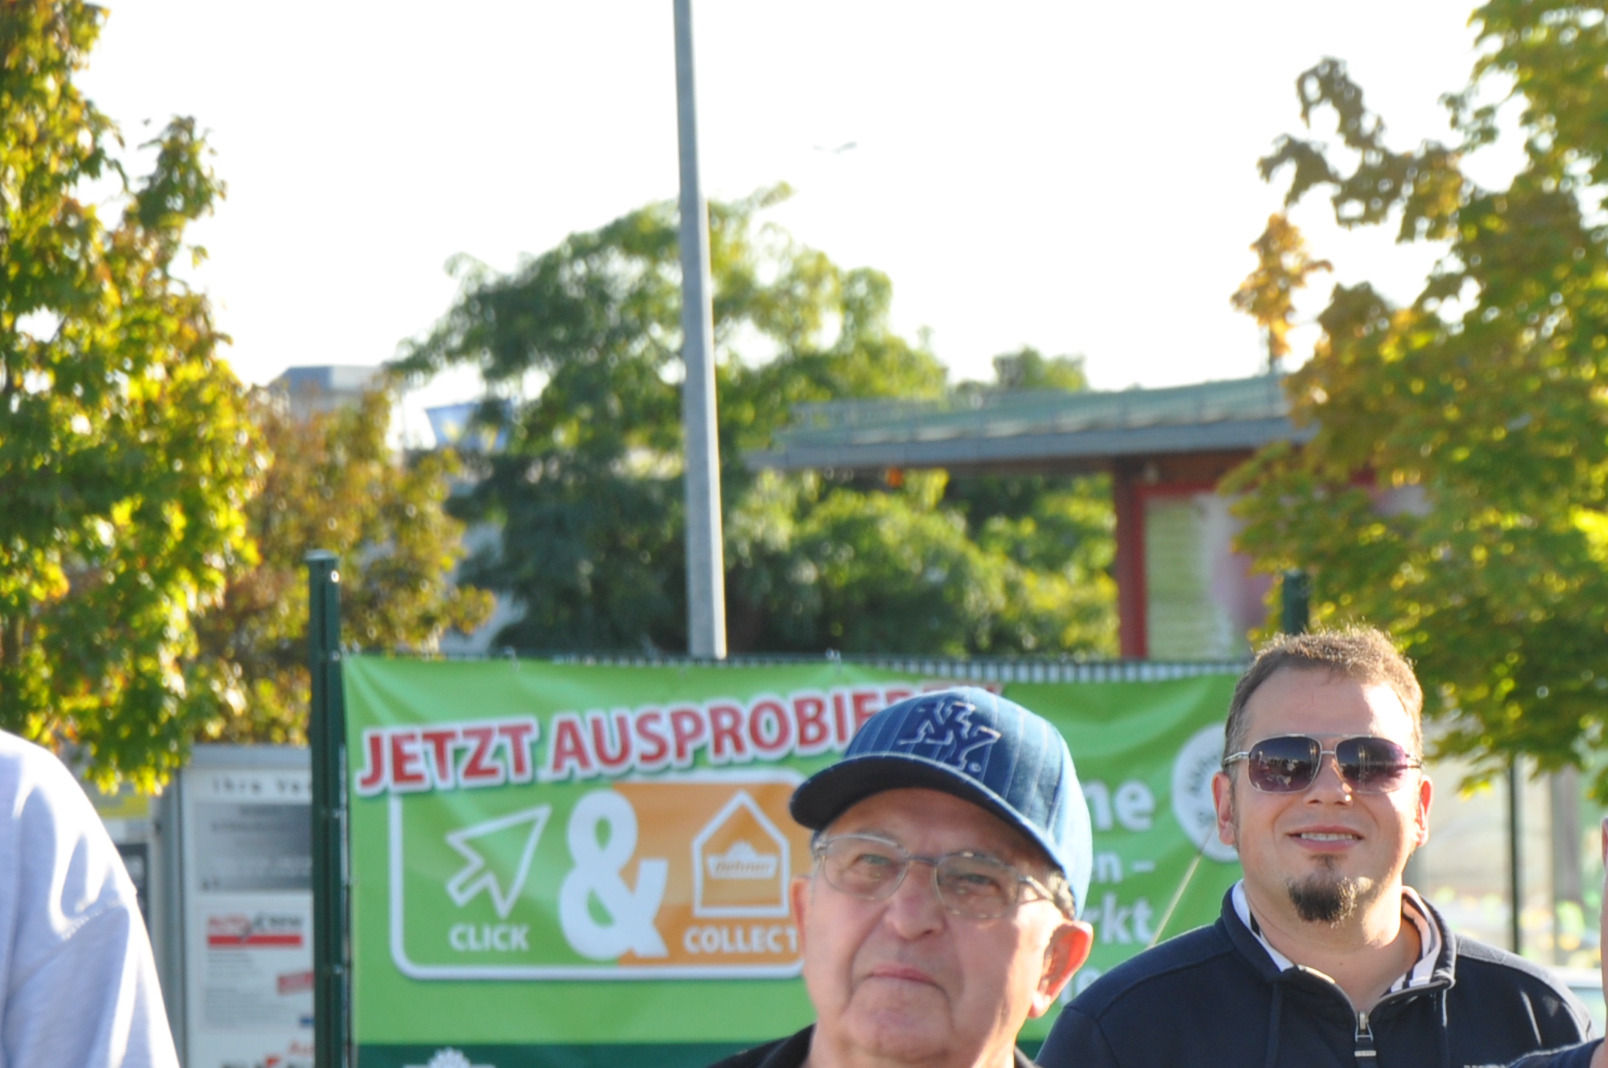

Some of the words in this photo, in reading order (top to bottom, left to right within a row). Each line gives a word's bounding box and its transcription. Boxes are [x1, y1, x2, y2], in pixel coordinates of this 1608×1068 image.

[357, 721, 536, 791] JETZT
[552, 684, 985, 773] AUSPROBIE
[1081, 780, 1155, 831] ne
[449, 923, 530, 952] CLICK
[559, 789, 670, 962] &
[683, 925, 800, 953] COLLECT
